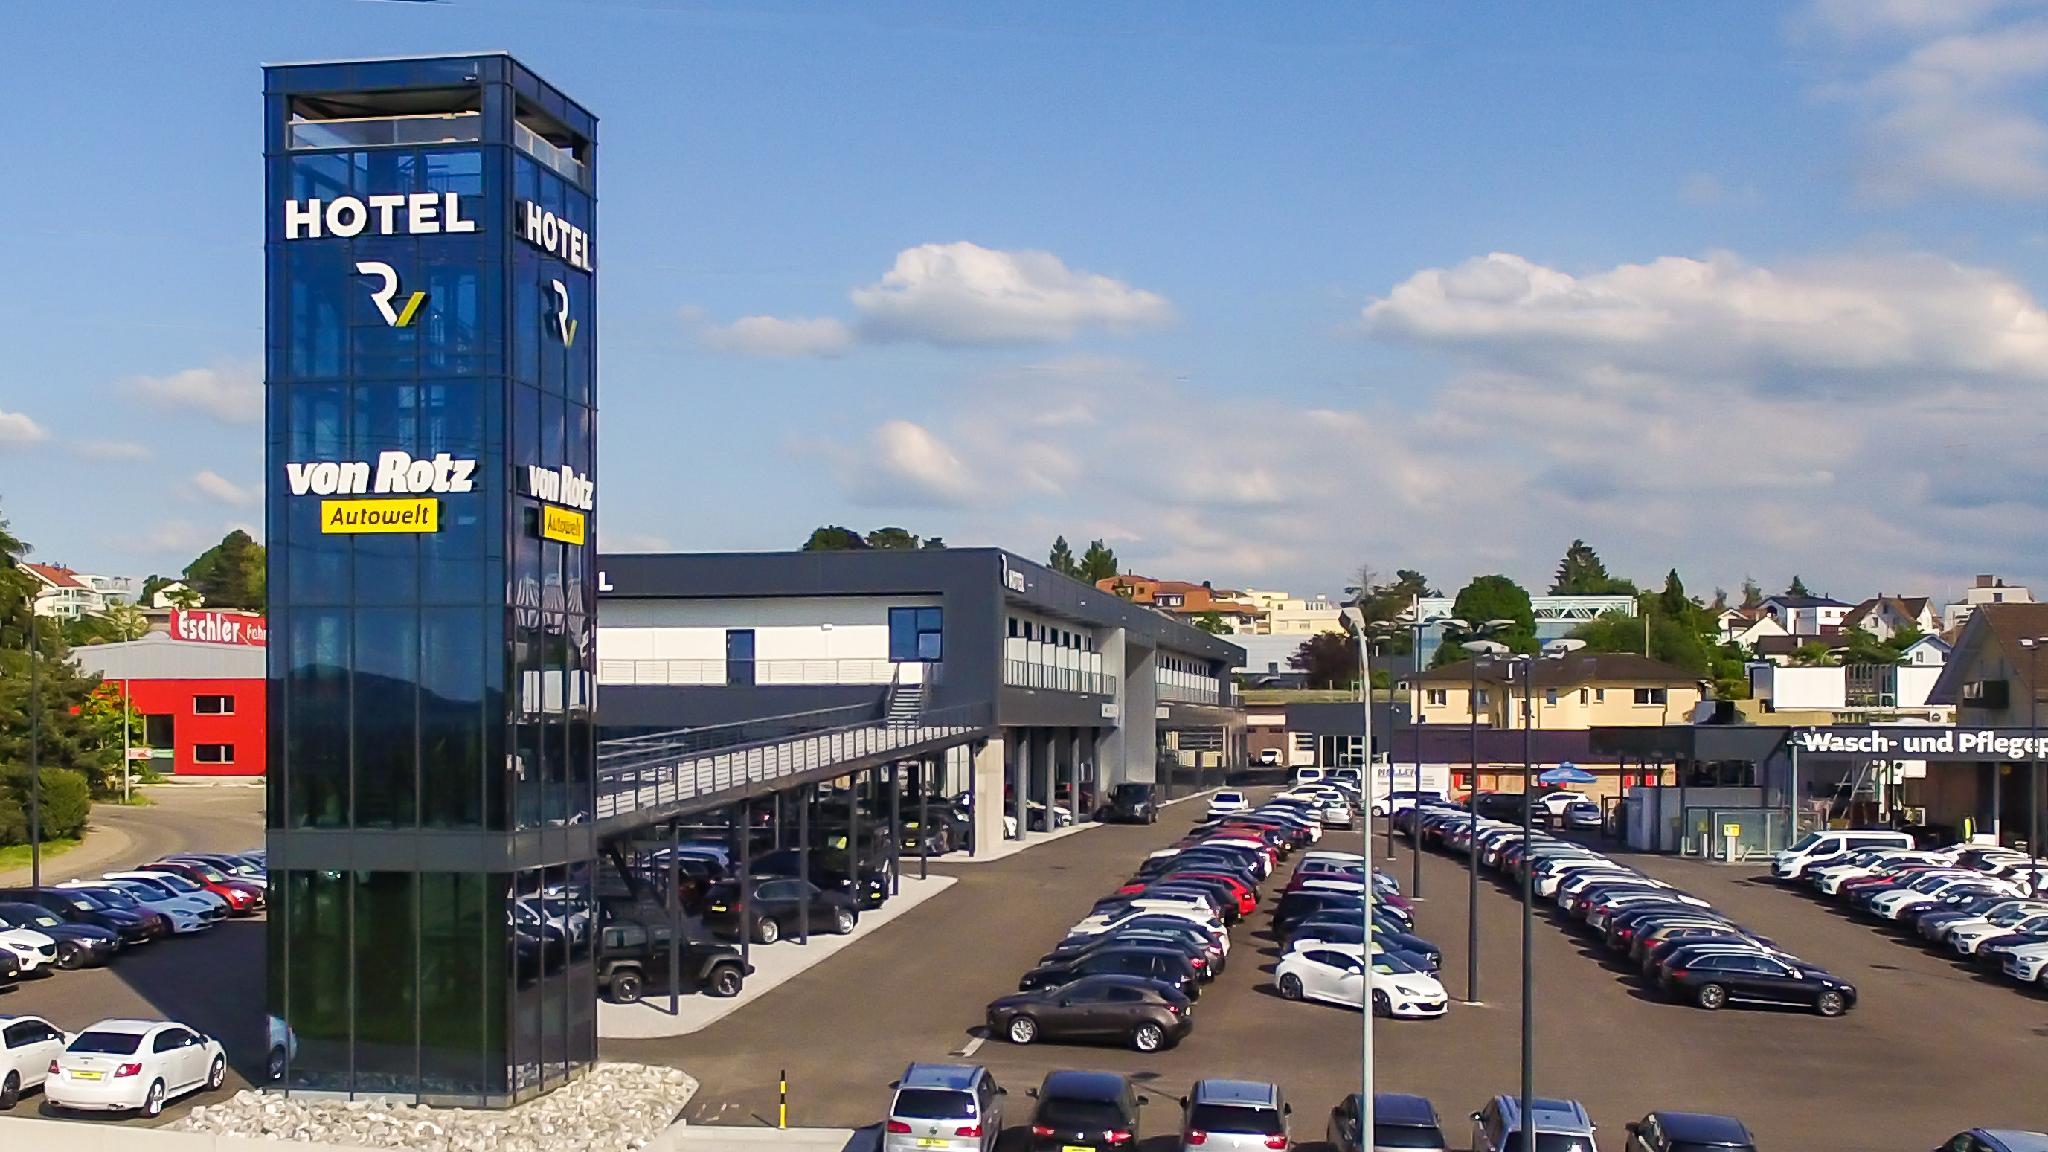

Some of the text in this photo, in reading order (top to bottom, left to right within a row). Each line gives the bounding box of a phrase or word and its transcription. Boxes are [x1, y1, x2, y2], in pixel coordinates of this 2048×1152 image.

[286, 192, 475, 240] HOTEL
[526, 200, 593, 272] HOTEL
[286, 451, 475, 495] von Rotz
[528, 464, 594, 510] von Rotz
[330, 503, 429, 526] Autowelt
[179, 610, 241, 642] Eschler
[1803, 729, 1899, 752] Wasch-
[1903, 730, 1953, 753] und
